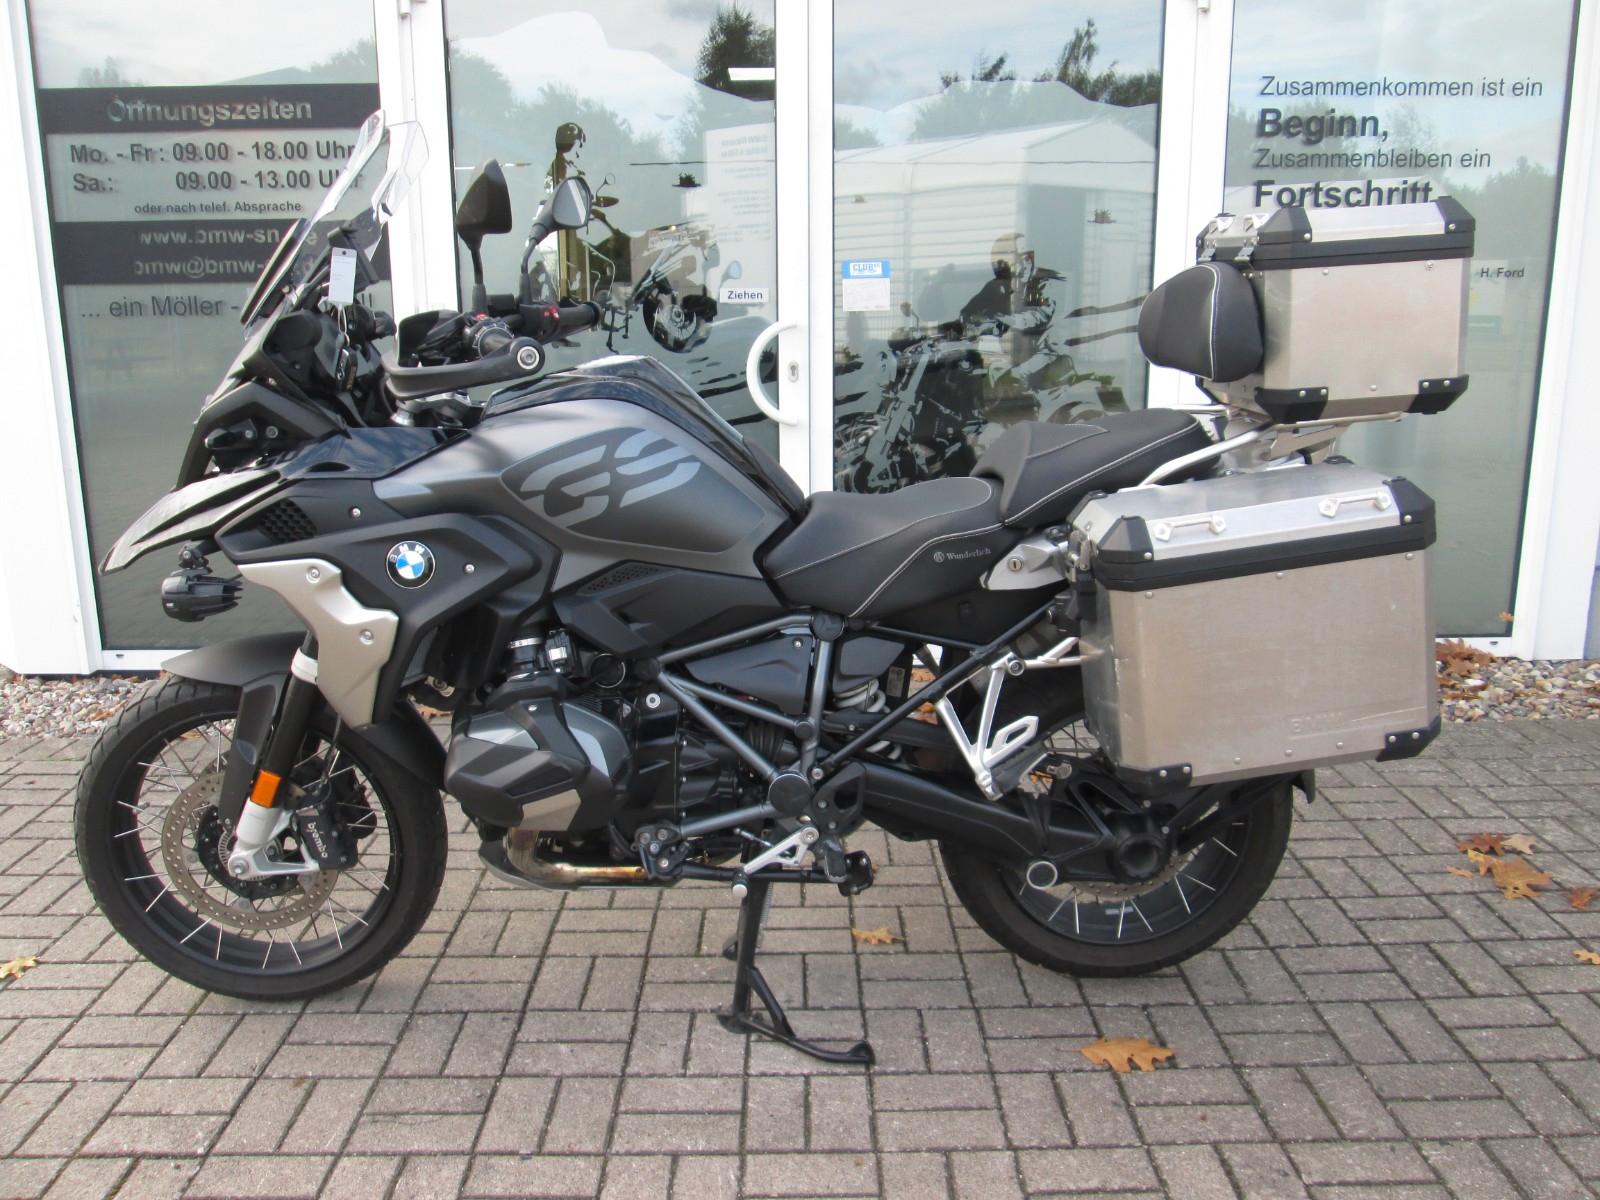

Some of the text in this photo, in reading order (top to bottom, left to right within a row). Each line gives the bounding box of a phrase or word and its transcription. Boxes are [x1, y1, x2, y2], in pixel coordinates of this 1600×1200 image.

[1260, 76, 1544, 97] Zusammenkommen ist ein
[1258, 107, 1388, 144] Beginn,
[70, 144, 108, 163] Mo.
[172, 141, 229, 161] 09.00
[252, 140, 308, 160] 18.00
[316, 140, 355, 159] Uhr
[1256, 148, 1491, 169] Zusammenbleiben ein
[73, 173, 113, 192] Sa.:
[175, 171, 232, 190] 09.00
[254, 169, 311, 189] 13.00
[134, 200, 302, 214] oder nach telef. Absprache
[1480, 267, 1526, 279] H. Ford
[109, 297, 143, 318] ein
[151, 295, 223, 317] Möller
[727, 290, 764, 301] Ziehen
[520, 428, 701, 528] GS
[307, 822, 328, 858] brembo
